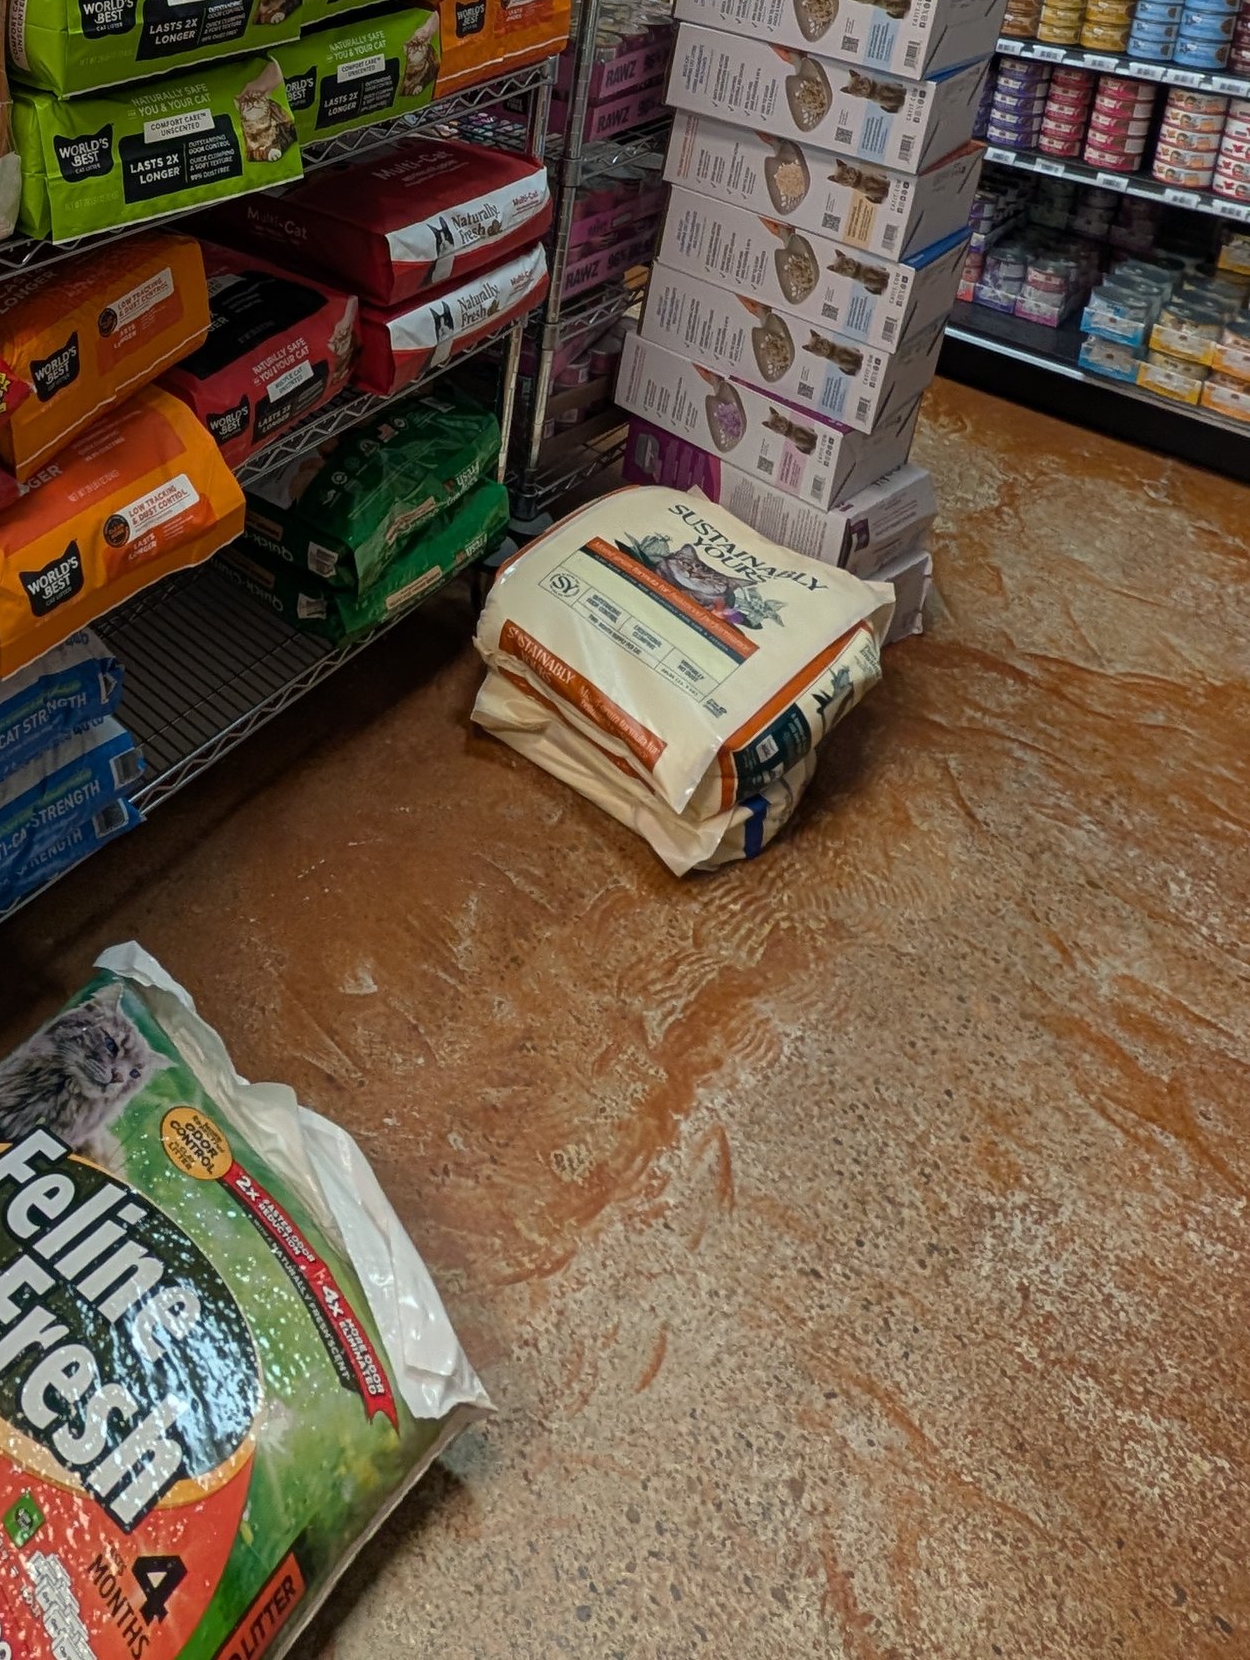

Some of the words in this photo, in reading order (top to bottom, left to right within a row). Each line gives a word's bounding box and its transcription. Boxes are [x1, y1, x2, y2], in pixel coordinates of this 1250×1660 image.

[94, 9, 123, 24] BEST
[150, 21, 182, 35] LASTS
[184, 18, 198, 30] 2X
[11, 14, 21, 61] COMFORT
[155, 30, 197, 45] LONGER
[606, 61, 636, 86] RAWZ
[138, 104, 160, 117] YOU
[168, 98, 194, 112] YOUR
[194, 94, 212, 106] CAT
[596, 106, 630, 131] RAWZ
[150, 117, 182, 131] COMFORT
[160, 122, 201, 137] UNSCENTED
[59, 137, 109, 159] WORLD'S
[70, 152, 99, 168] BEST
[130, 157, 164, 174] LASTS
[167, 153, 179, 165] 2X
[139, 166, 180, 185] LONGER
[371, 150, 453, 182] Multi-Cat
[247, 206, 309, 240] Multi-Cat
[452, 203, 499, 230] Naturally
[460, 222, 486, 245] Fresh
[567, 263, 599, 284] RAWZ
[118, 299, 132, 312] LOW
[131, 277, 163, 303] TRACKING
[457, 283, 499, 314] Naturally
[461, 307, 487, 328] Fresh
[129, 505, 145, 518] LOW
[145, 485, 177, 510] TRACKING
[139, 507, 157, 523] DUST
[158, 490, 189, 514] CONTROL
[668, 503, 829, 592] SUSTAINABLY
[690, 536, 768, 584] YOURS
[28, 557, 79, 595] WORLD'S
[507, 625, 576, 686] SUSTAINABLY
[185, 1121, 219, 1160] ODOR
[132, 1555, 188, 1626] 4
[87, 1553, 150, 1660] MONTHS
[238, 1573, 298, 1658] LITTER
